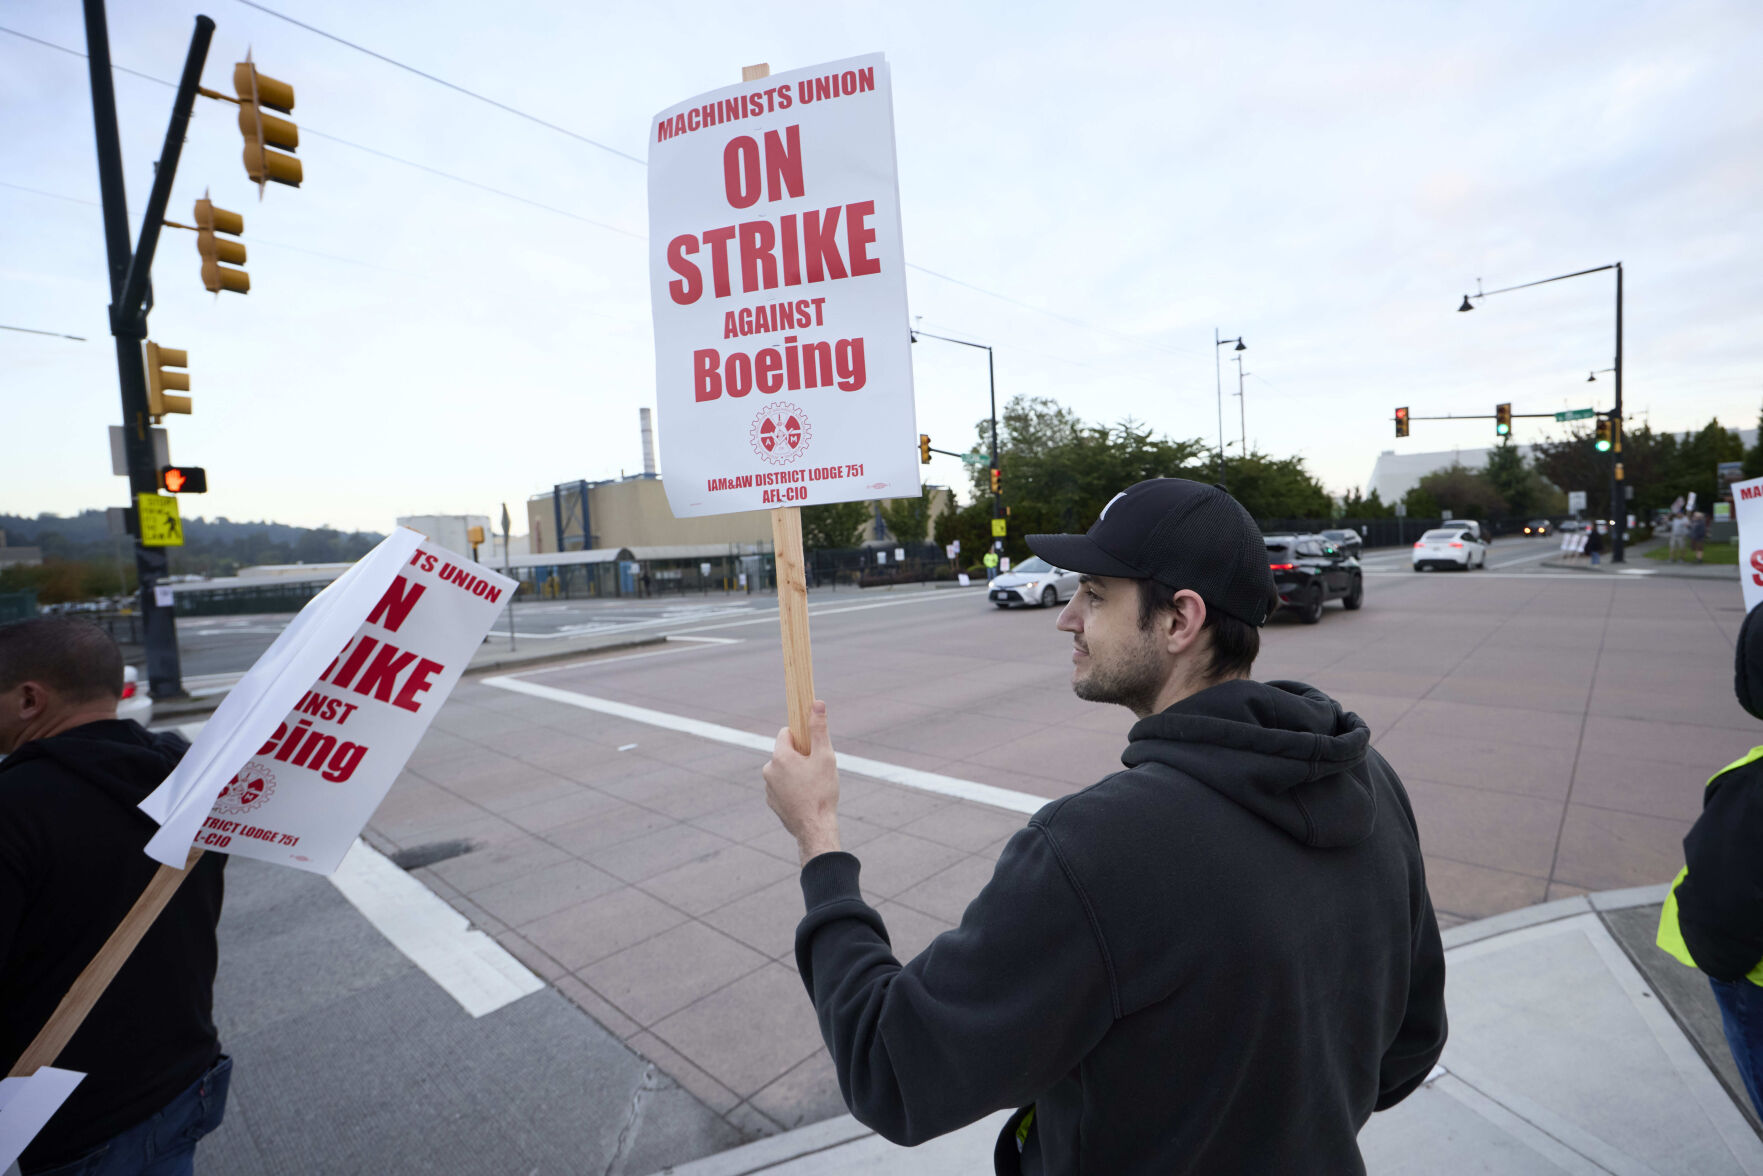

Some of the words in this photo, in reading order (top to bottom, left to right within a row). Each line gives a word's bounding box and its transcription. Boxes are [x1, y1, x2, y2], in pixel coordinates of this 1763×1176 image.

[657, 84, 793, 143] MACHINISTS
[798, 66, 875, 105] UNION
[723, 124, 805, 209] ON
[666, 199, 881, 306] STRIKE
[723, 297, 826, 339] AGAINST
[693, 335, 867, 403] Boeing
[707, 474, 753, 492] IAM&AW
[755, 469, 806, 486] DISTRICT
[808, 465, 843, 482] LODGE
[846, 463, 864, 477] 751
[762, 485, 808, 503] AFL-CIO
[1740, 485, 1763, 501] MA
[365, 574, 427, 633] N
[438, 562, 502, 604] UNION
[318, 634, 445, 713] IKE
[293, 690, 359, 725] INST
[255, 718, 369, 784] eing
[193, 830, 232, 849] L-CIO
[202, 816, 242, 834] TRICT
[239, 824, 280, 843] LODGE
[277, 834, 301, 848] 751
